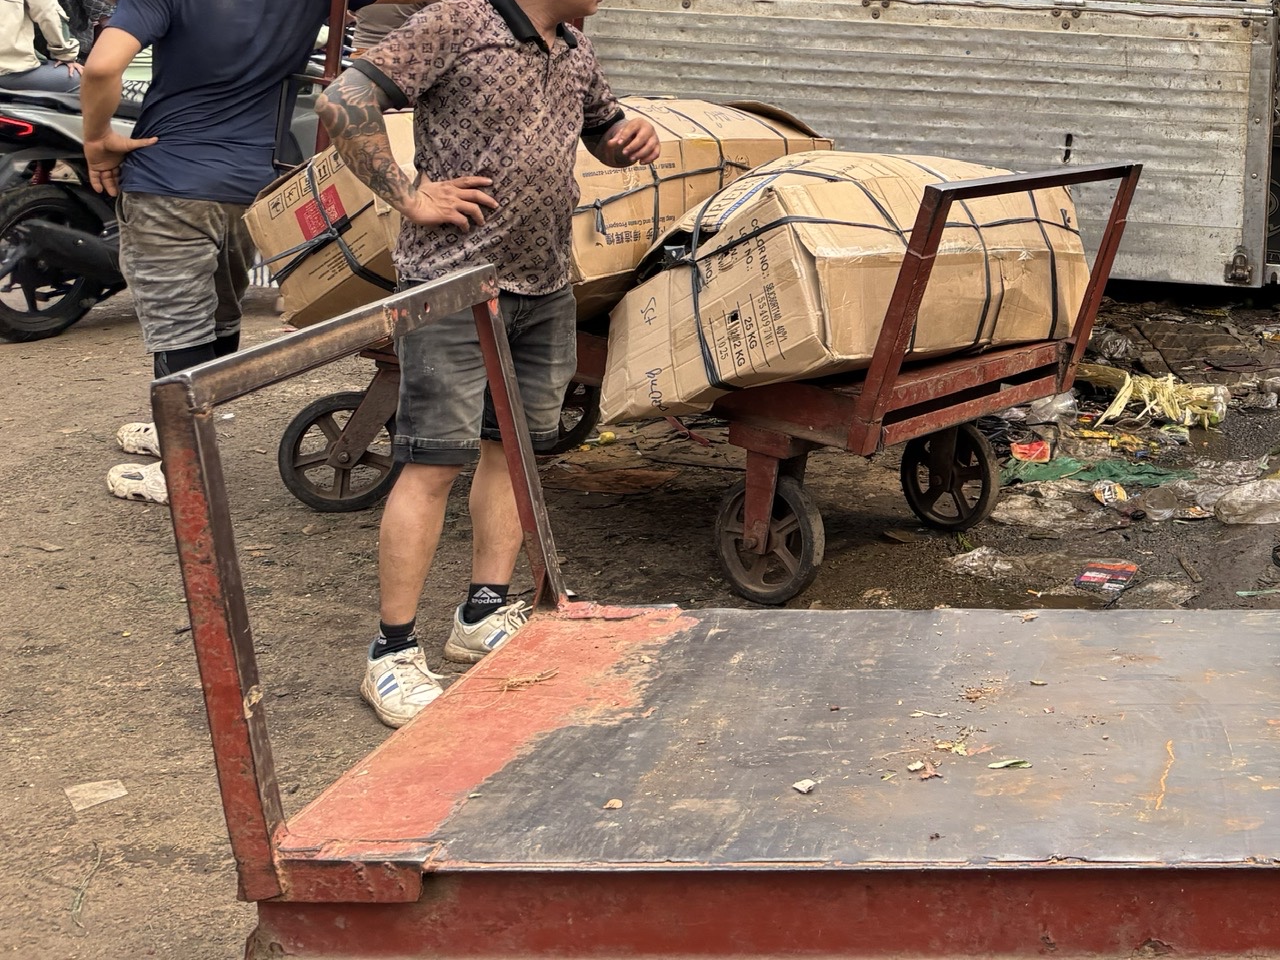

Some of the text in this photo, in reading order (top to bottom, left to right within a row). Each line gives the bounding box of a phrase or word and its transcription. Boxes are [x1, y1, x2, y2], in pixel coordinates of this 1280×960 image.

[744, 316, 754, 332] 25
[716, 335, 729, 360] 1025
[748, 330, 758, 350] KG
[735, 346, 746, 368] KG
